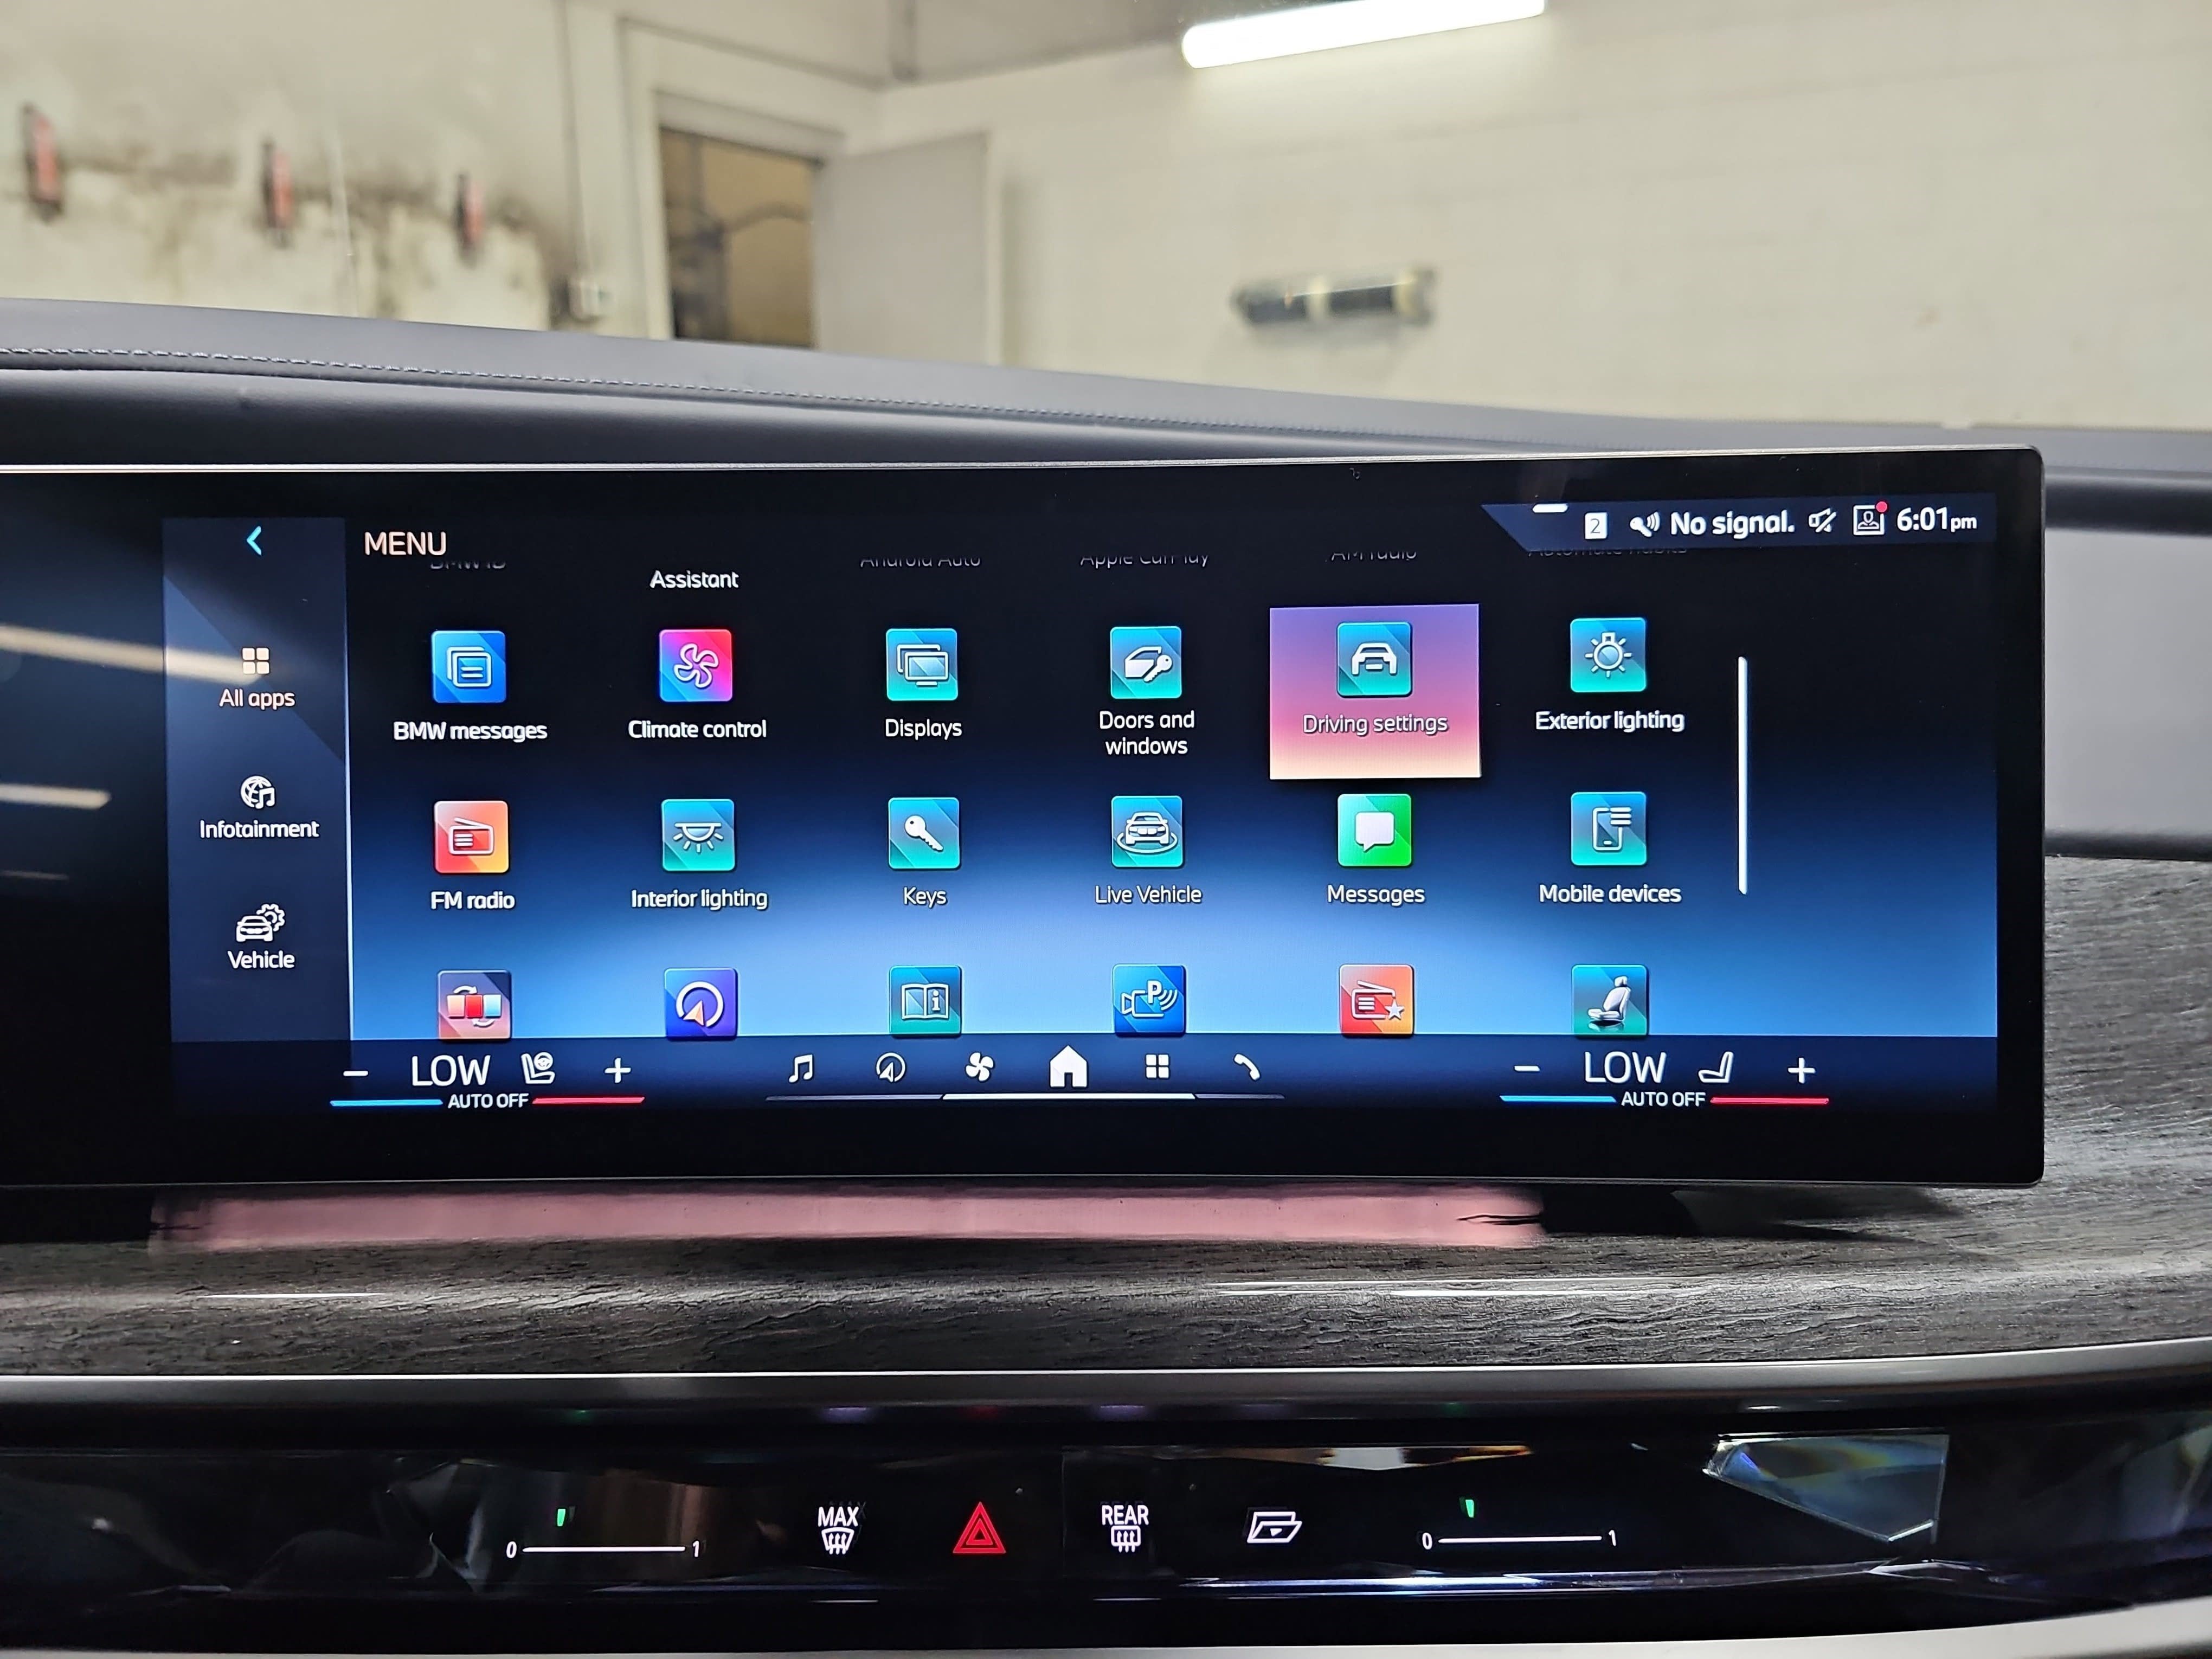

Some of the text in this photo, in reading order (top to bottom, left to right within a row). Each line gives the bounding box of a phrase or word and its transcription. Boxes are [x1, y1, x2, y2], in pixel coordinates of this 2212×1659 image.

[1590, 518, 1600, 534] 2
[1671, 510, 1795, 539] No signal.
[365, 531, 446, 556] MENU
[650, 570, 739, 588] Assistant
[219, 689, 295, 710] All apps
[628, 719, 767, 738] Climate control
[885, 718, 962, 741] Displays
[1099, 710, 1194, 729] Doors and
[1303, 713, 1448, 736] Driving settings
[1536, 710, 1684, 733] Exterior lighting
[394, 721, 548, 743] BMW messages
[1105, 736, 1188, 755] windows
[200, 819, 320, 838] Infotainment
[431, 891, 515, 909] FM radio
[632, 889, 767, 910] Interior lighting
[904, 887, 946, 908] Keys
[1096, 885, 1201, 903] Live Vehicle
[1328, 885, 1425, 906] Messages
[1540, 884, 1682, 903] Mobile devices
[227, 950, 295, 969] Vehicle
[412, 1054, 491, 1086] LOW
[1585, 1051, 1666, 1083] LOW
[448, 1093, 529, 1109] AUTO OFF
[1621, 1091, 1706, 1107] AUTO OFF
[818, 1506, 859, 1527] MAX
[1102, 1504, 1149, 1525] REAR
